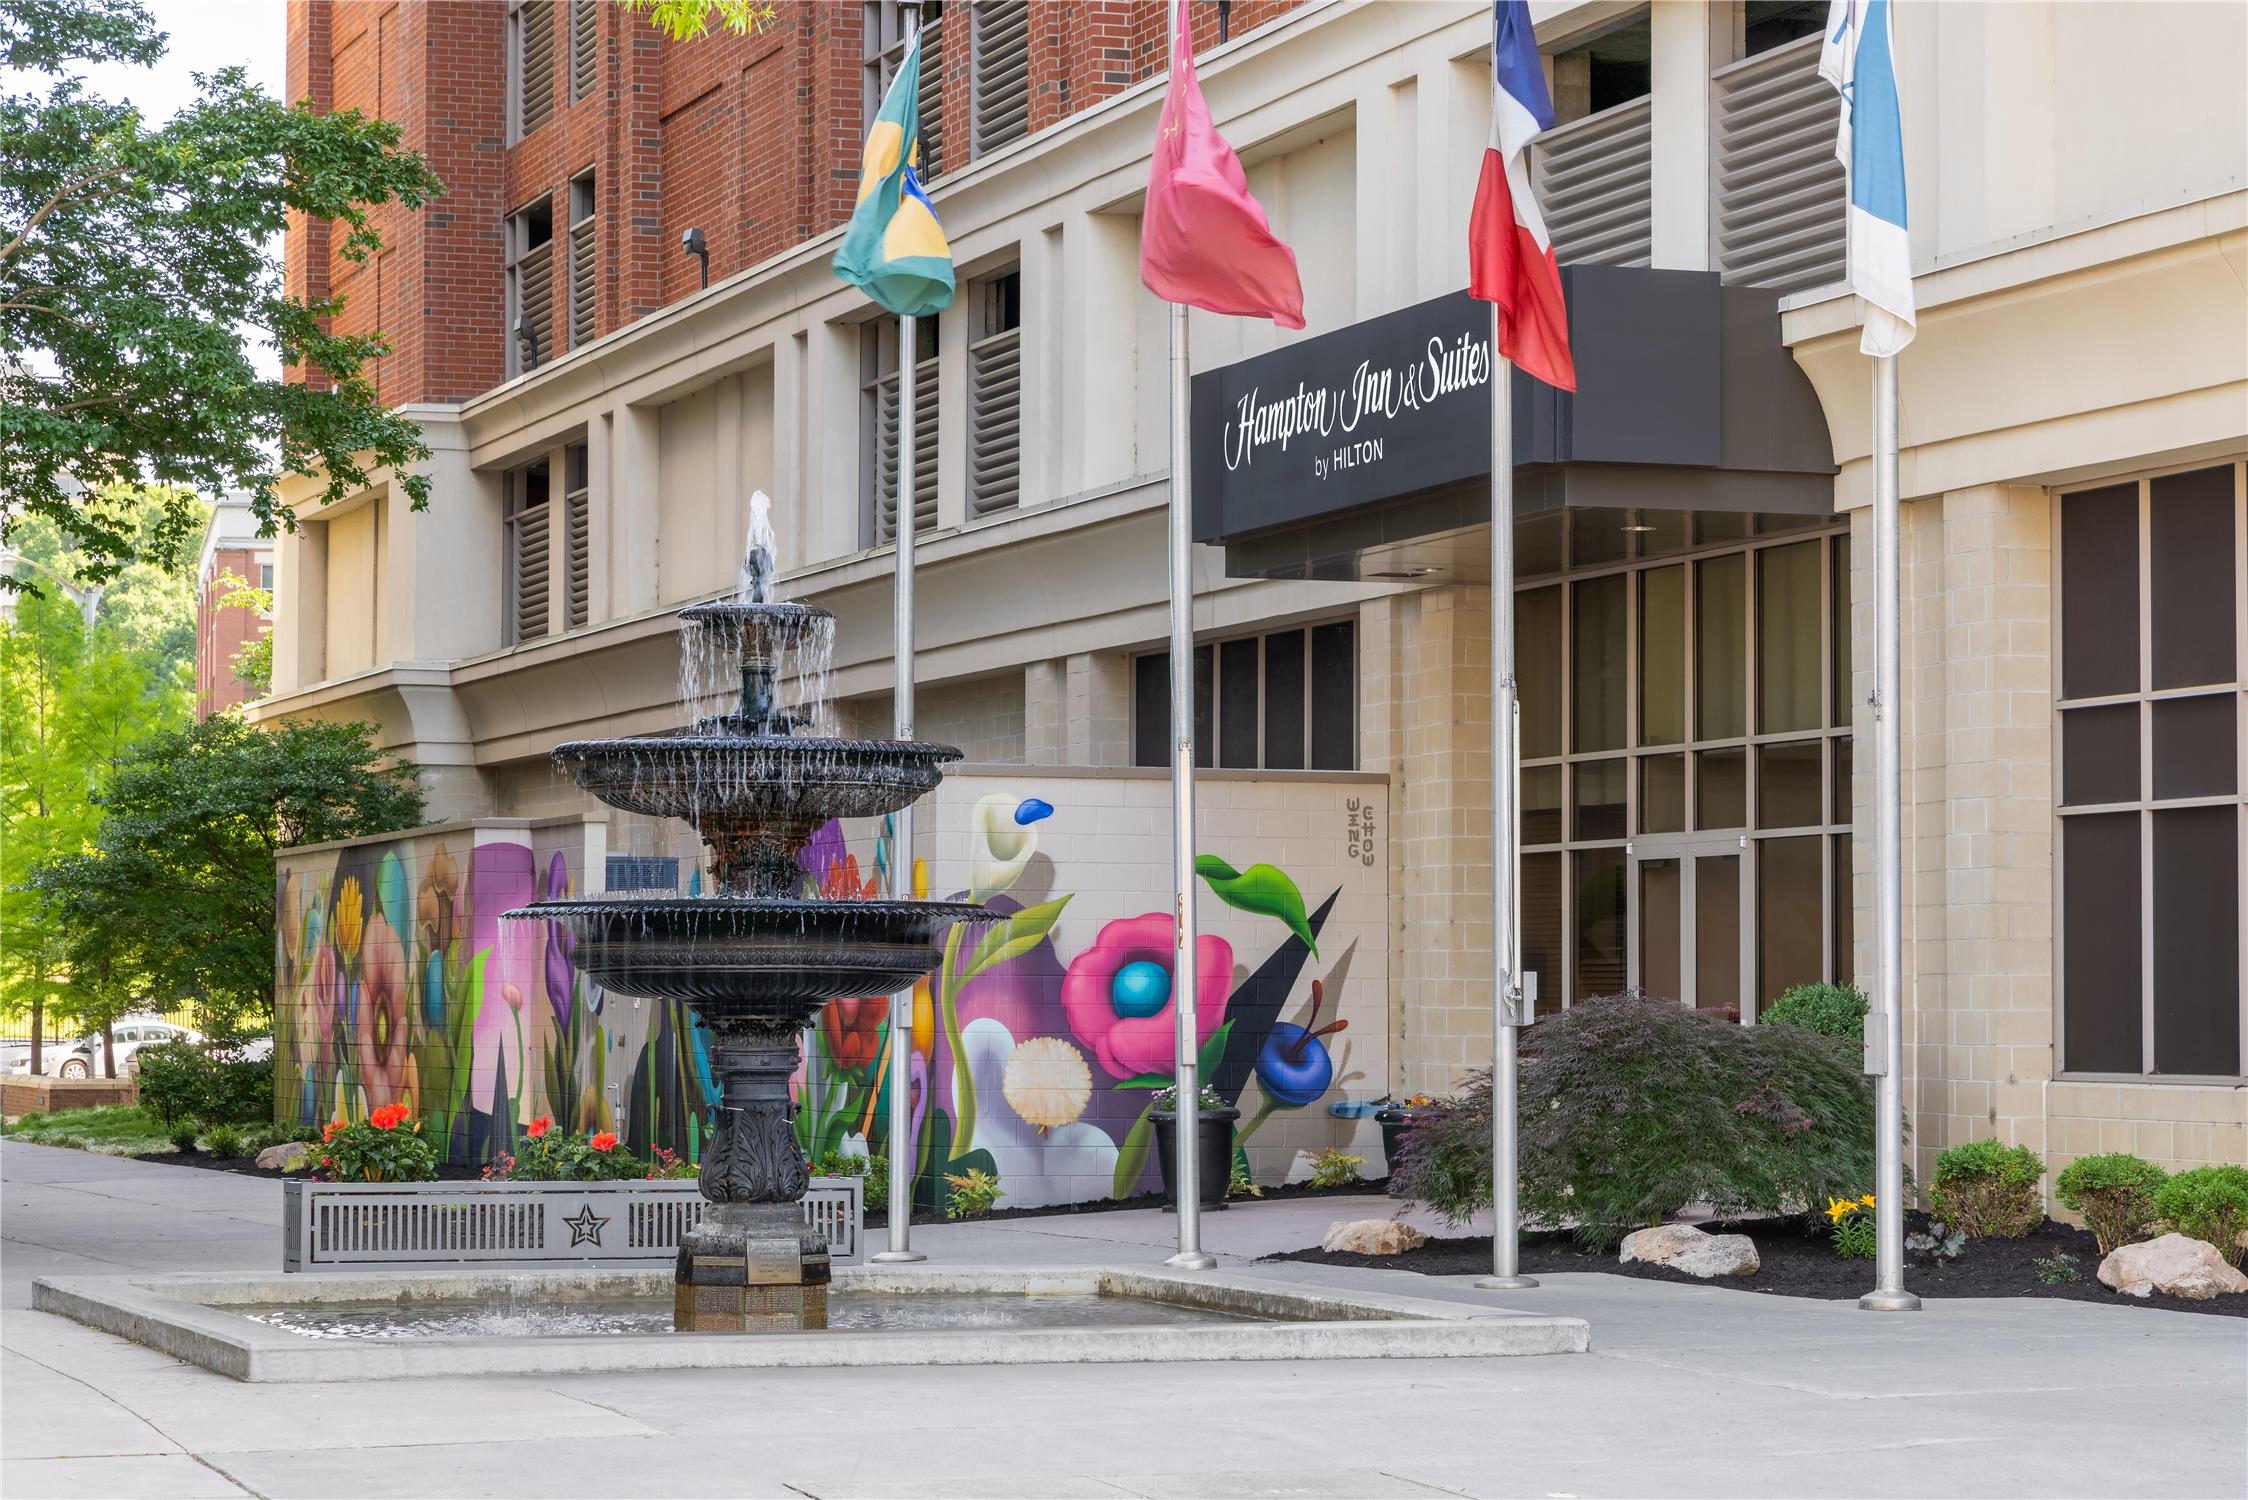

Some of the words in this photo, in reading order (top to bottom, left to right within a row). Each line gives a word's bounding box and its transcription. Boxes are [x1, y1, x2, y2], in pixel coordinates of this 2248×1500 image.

[1224, 381, 1337, 471] Hampton
[1340, 359, 1404, 433] Inn
[1404, 363, 1421, 411] &
[1419, 331, 1490, 403] Suites
[1315, 455, 1329, 481] by
[1333, 437, 1383, 471] HILTON
[1346, 797, 1360, 859] WING
